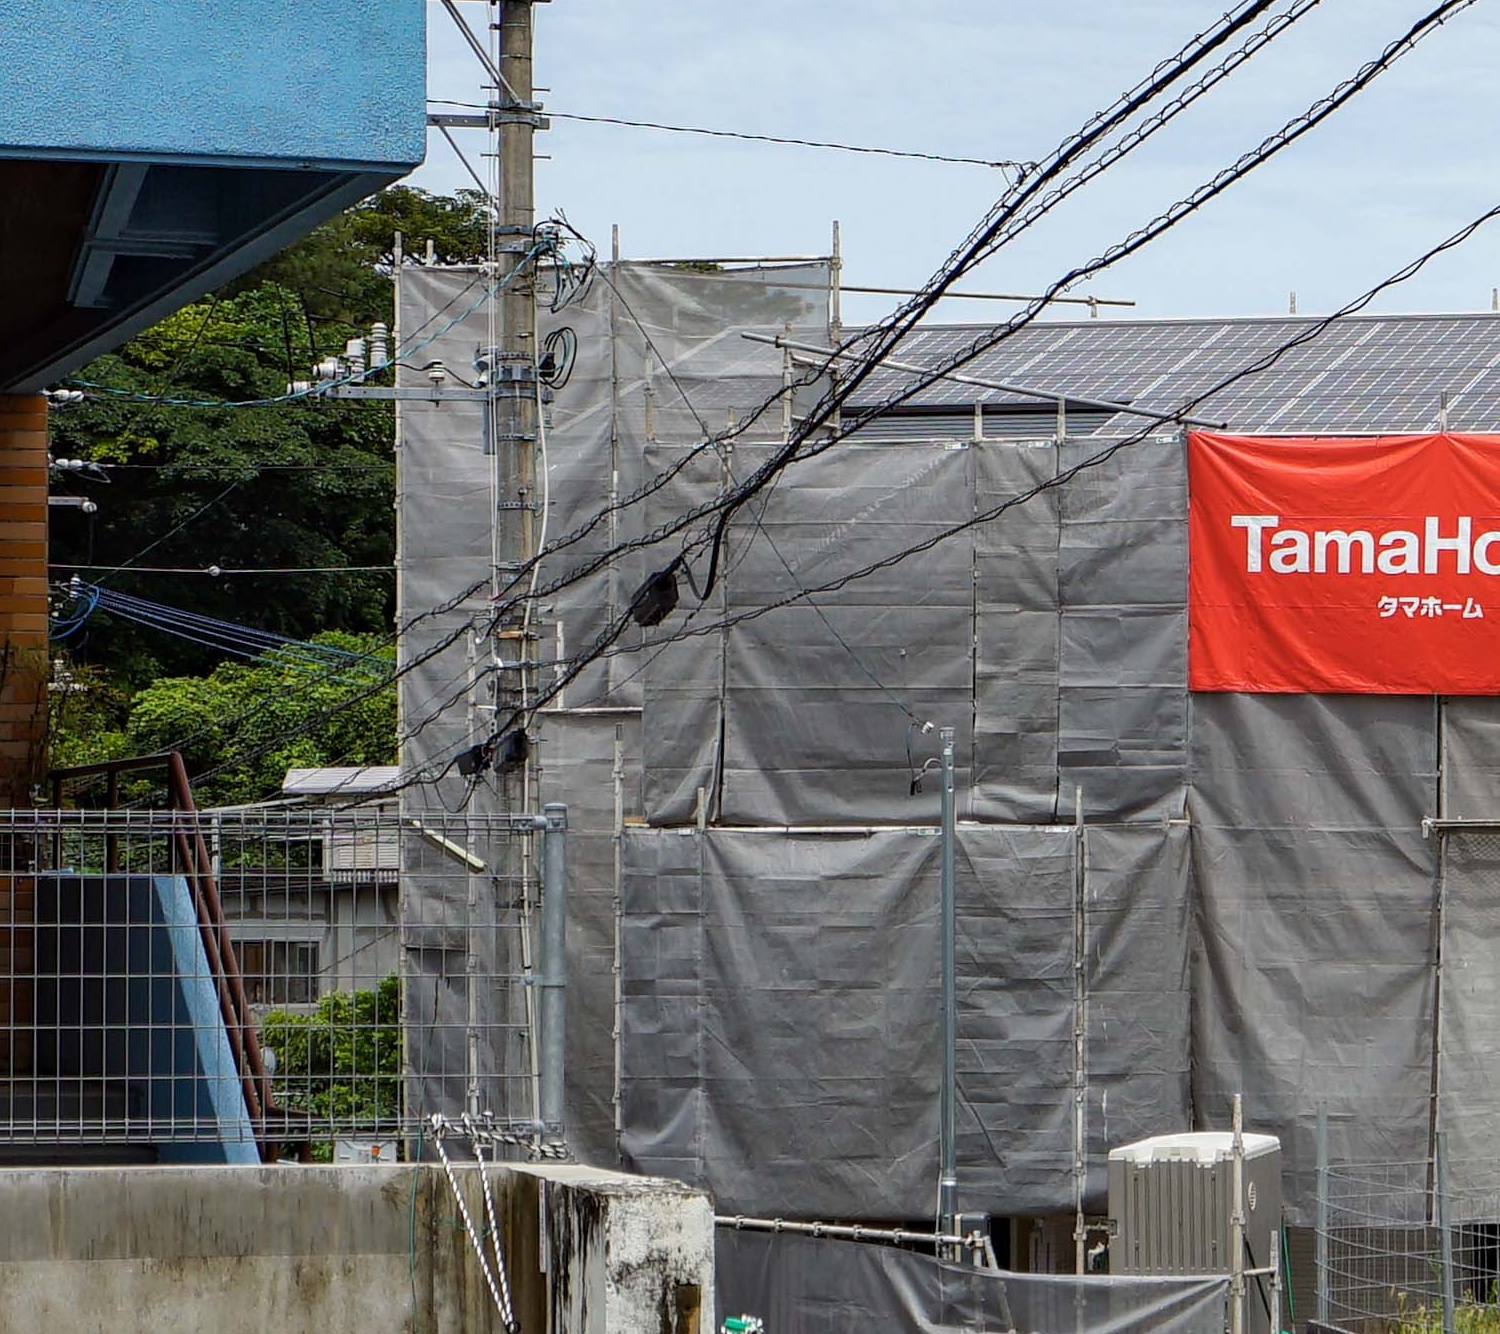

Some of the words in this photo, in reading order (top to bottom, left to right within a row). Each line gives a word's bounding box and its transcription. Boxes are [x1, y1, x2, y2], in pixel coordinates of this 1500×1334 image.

[1377, 595, 1484, 620] タマホーム
